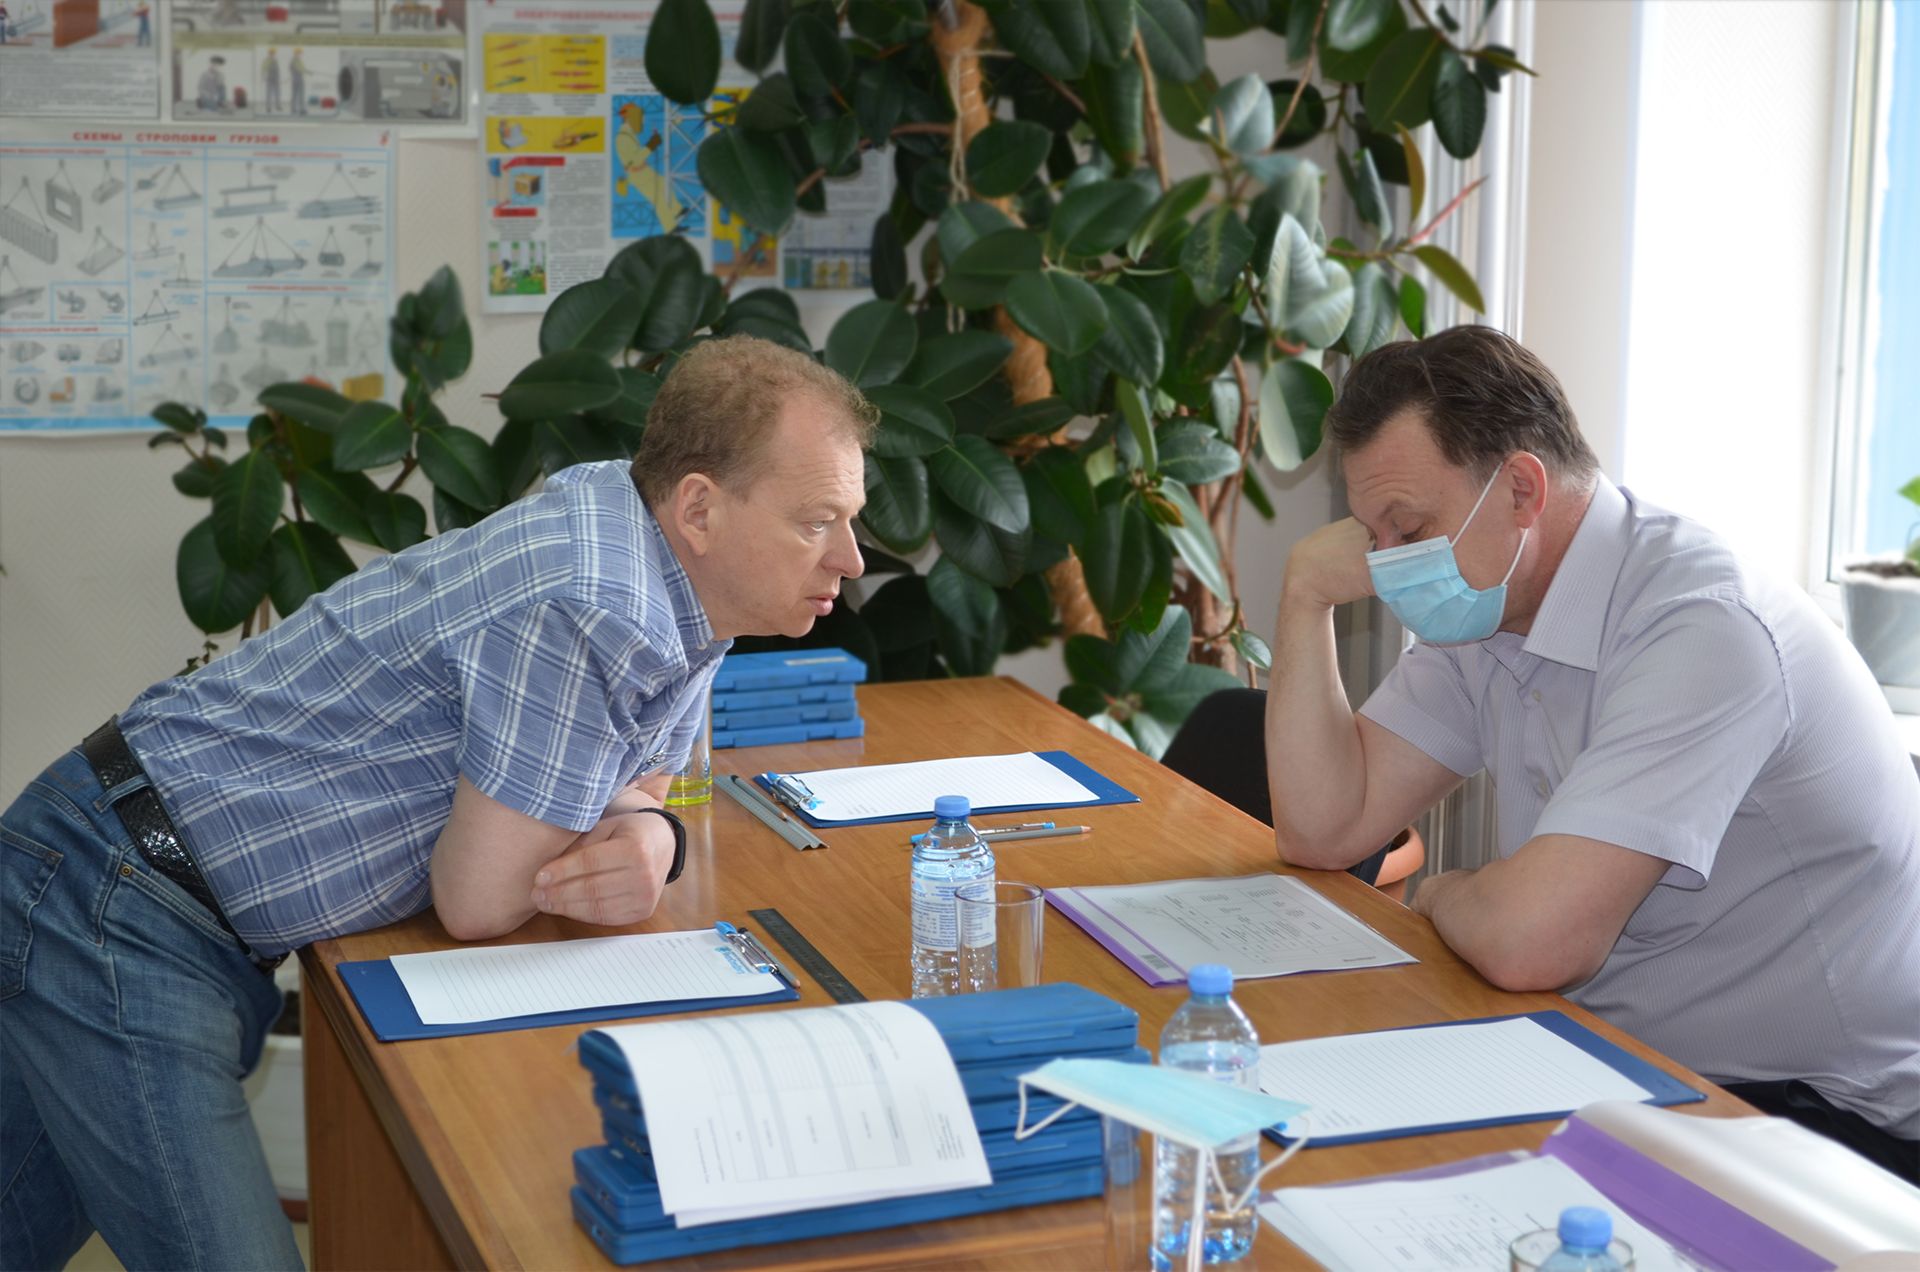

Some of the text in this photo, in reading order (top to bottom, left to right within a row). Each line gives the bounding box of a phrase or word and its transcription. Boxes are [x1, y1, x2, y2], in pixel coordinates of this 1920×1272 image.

[72, 131, 280, 144] СХЕМЫ СТРОПОВКИ ГРУЗОВ
